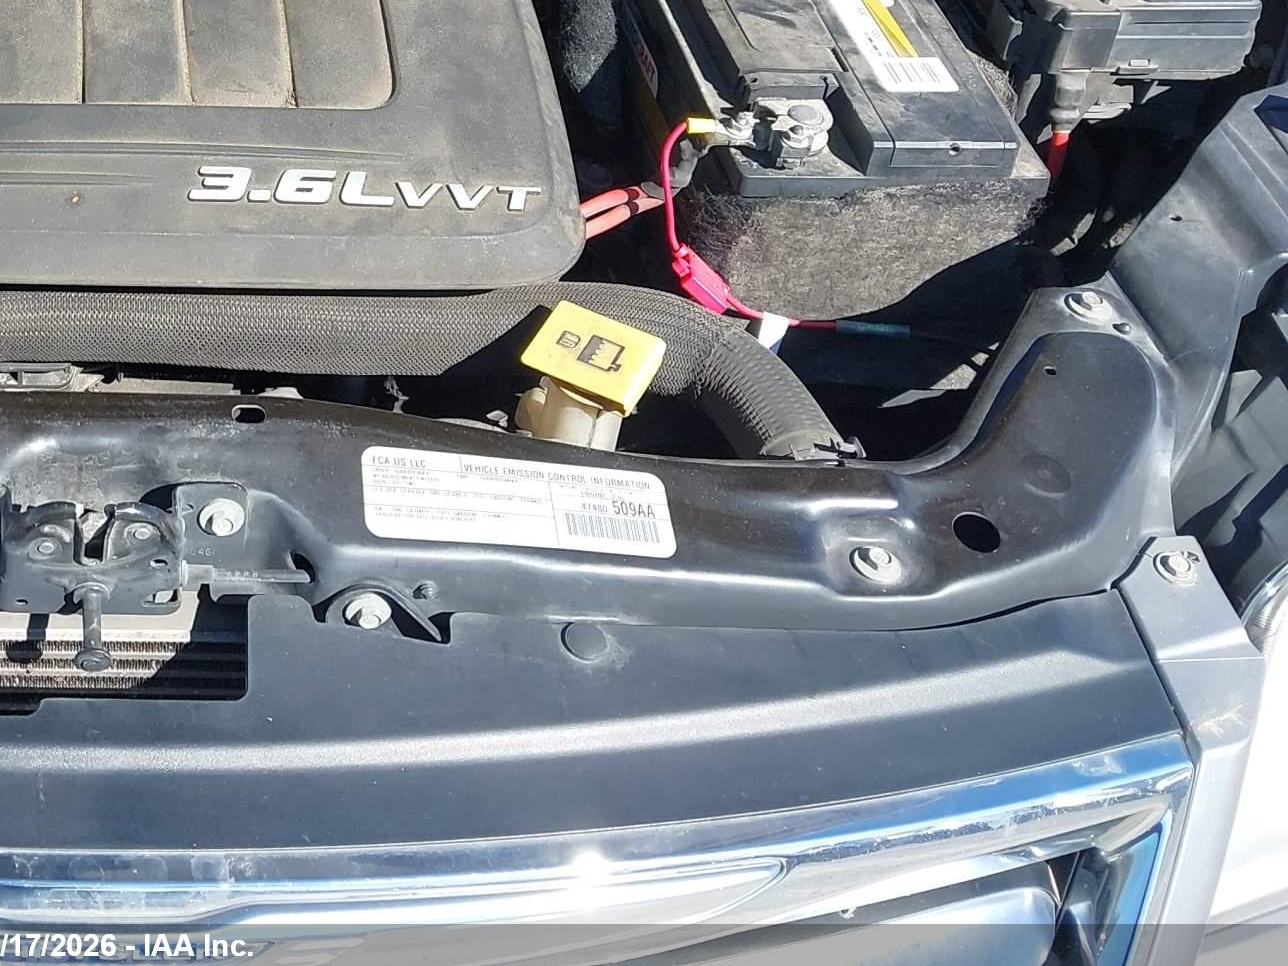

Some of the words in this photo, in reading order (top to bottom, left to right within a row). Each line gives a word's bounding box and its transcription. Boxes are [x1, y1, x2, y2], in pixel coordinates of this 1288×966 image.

[371, 455, 391, 465] FCA
[392, 456, 407, 467] US
[409, 457, 426, 468] LLC
[463, 463, 500, 477] VEHICLE
[502, 467, 545, 480] EMISSION
[547, 472, 587, 484] CONTROL
[590, 476, 651, 490] INFORMATION
[612, 500, 656, 519] 509AA
